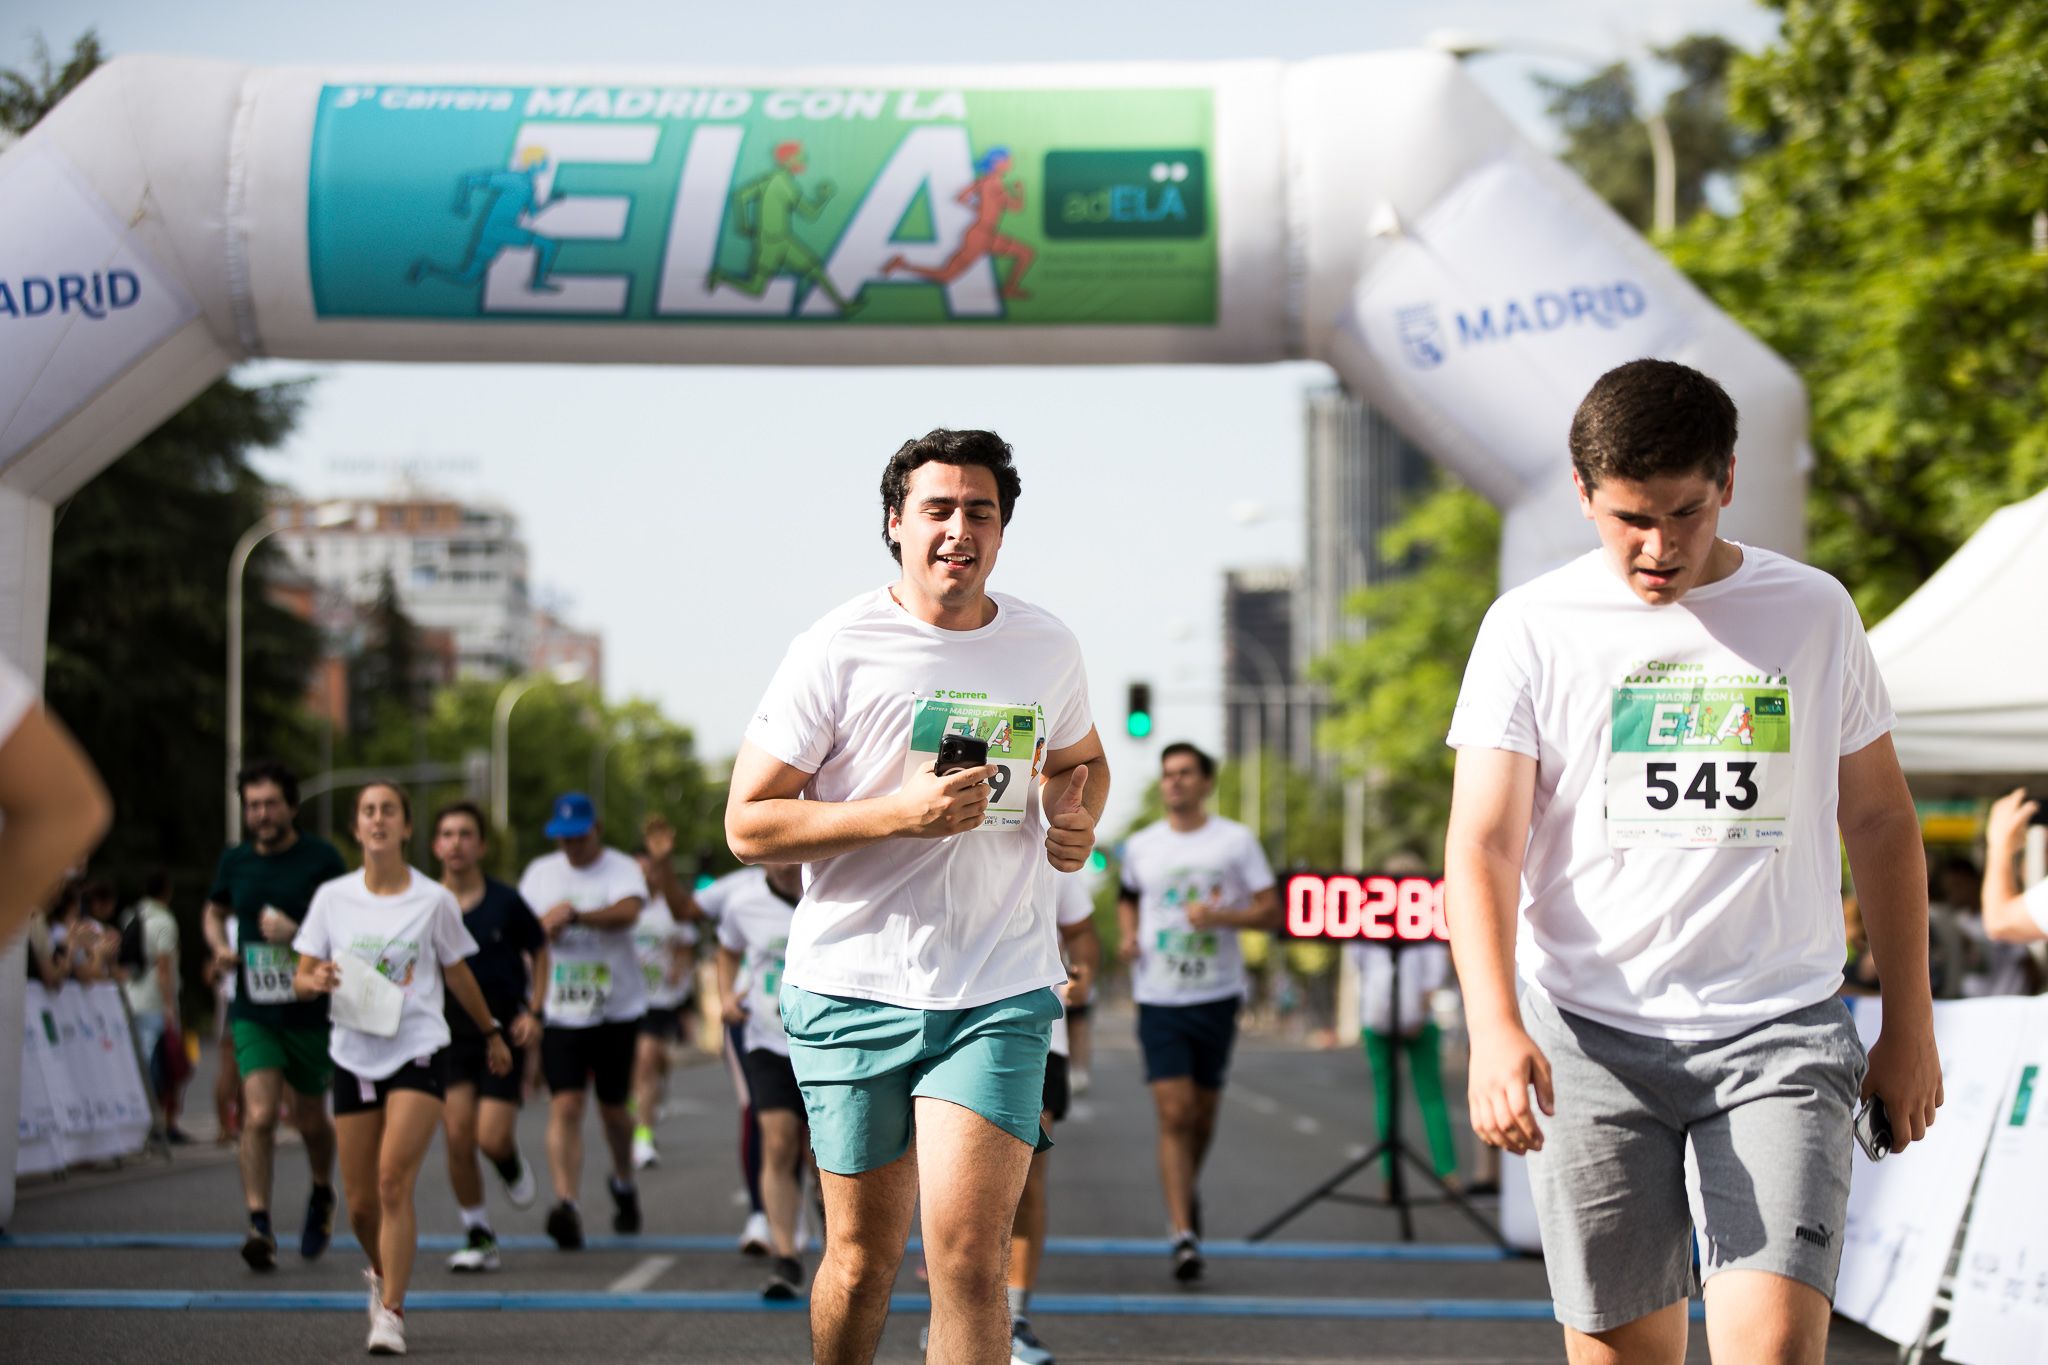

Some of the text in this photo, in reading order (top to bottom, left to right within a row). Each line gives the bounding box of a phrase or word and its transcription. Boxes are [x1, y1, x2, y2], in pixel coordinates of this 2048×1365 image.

[380, 89, 514, 110] Carrera
[522, 89, 752, 118] MADRID
[763, 91, 890, 119] CON
[894, 91, 968, 118] LA
[1063, 185, 1188, 222] adELA
[482, 122, 1009, 318] ELA
[1456, 281, 1646, 342] MADRID
[1647, 660, 1704, 671] Carrera
[948, 690, 987, 700] Carrera
[1655, 692, 1700, 702] MADRID
[1704, 692, 1728, 702] CON
[1729, 692, 1744, 702] LA
[950, 707, 980, 716] MADRID
[982, 709, 998, 718] CON
[998, 711, 1008, 719] LA
[1646, 702, 1753, 747] ELA
[1646, 761, 1759, 811] 543
[1795, 1225, 1826, 1249] PUMA
